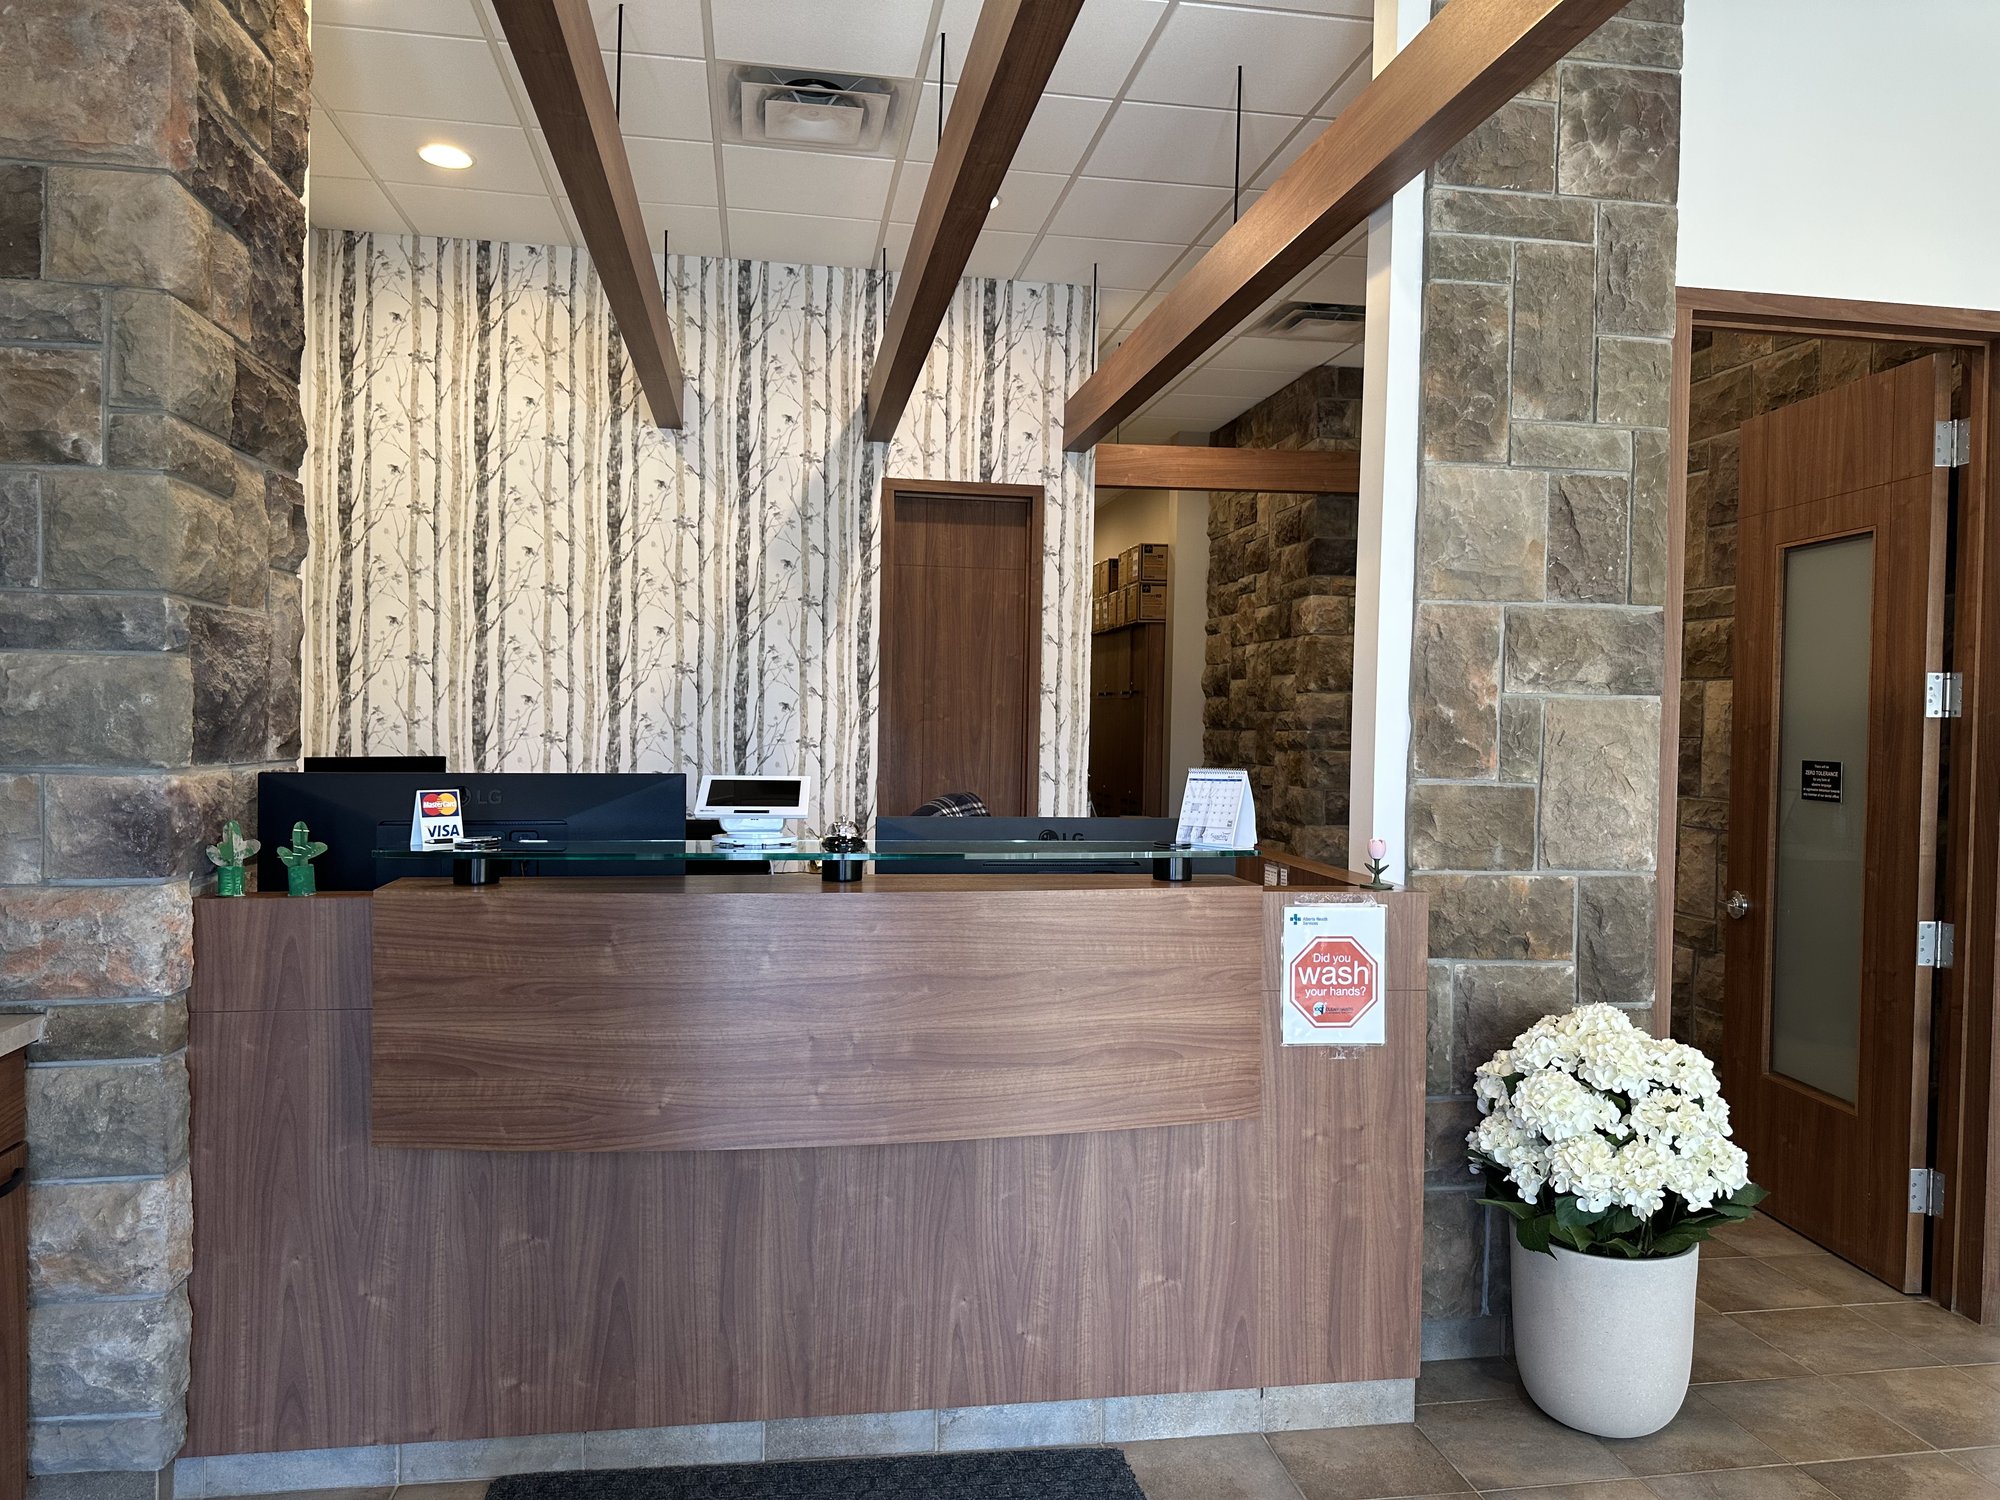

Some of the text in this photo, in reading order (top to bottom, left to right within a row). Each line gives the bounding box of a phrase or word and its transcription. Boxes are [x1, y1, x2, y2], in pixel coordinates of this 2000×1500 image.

[478, 789, 502, 804] LG
[425, 824, 460, 838] VISA
[1313, 953, 1351, 965] Did you
[1298, 960, 1369, 985] wash
[1305, 986, 1366, 998] your hands?
